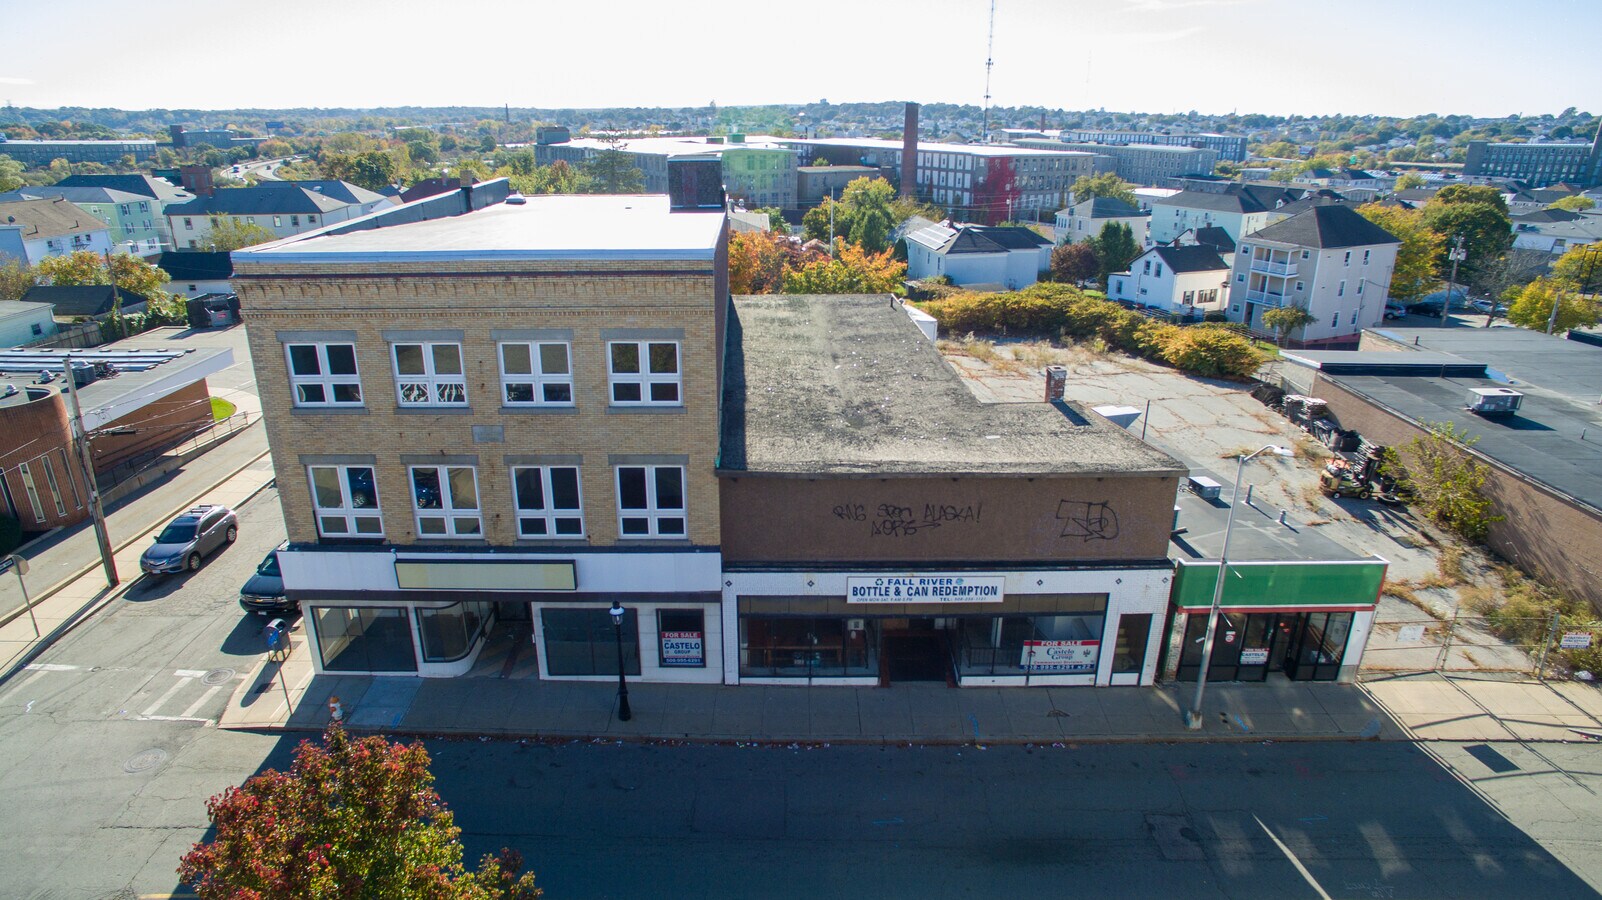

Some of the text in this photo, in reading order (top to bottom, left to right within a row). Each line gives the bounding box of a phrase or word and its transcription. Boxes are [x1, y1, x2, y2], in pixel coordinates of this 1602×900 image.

[887, 578, 953, 586] FALL RIVER
[852, 585, 998, 597] BOTTLE & CAN REDEMPTION
[1046, 647, 1075, 656] Castelo
